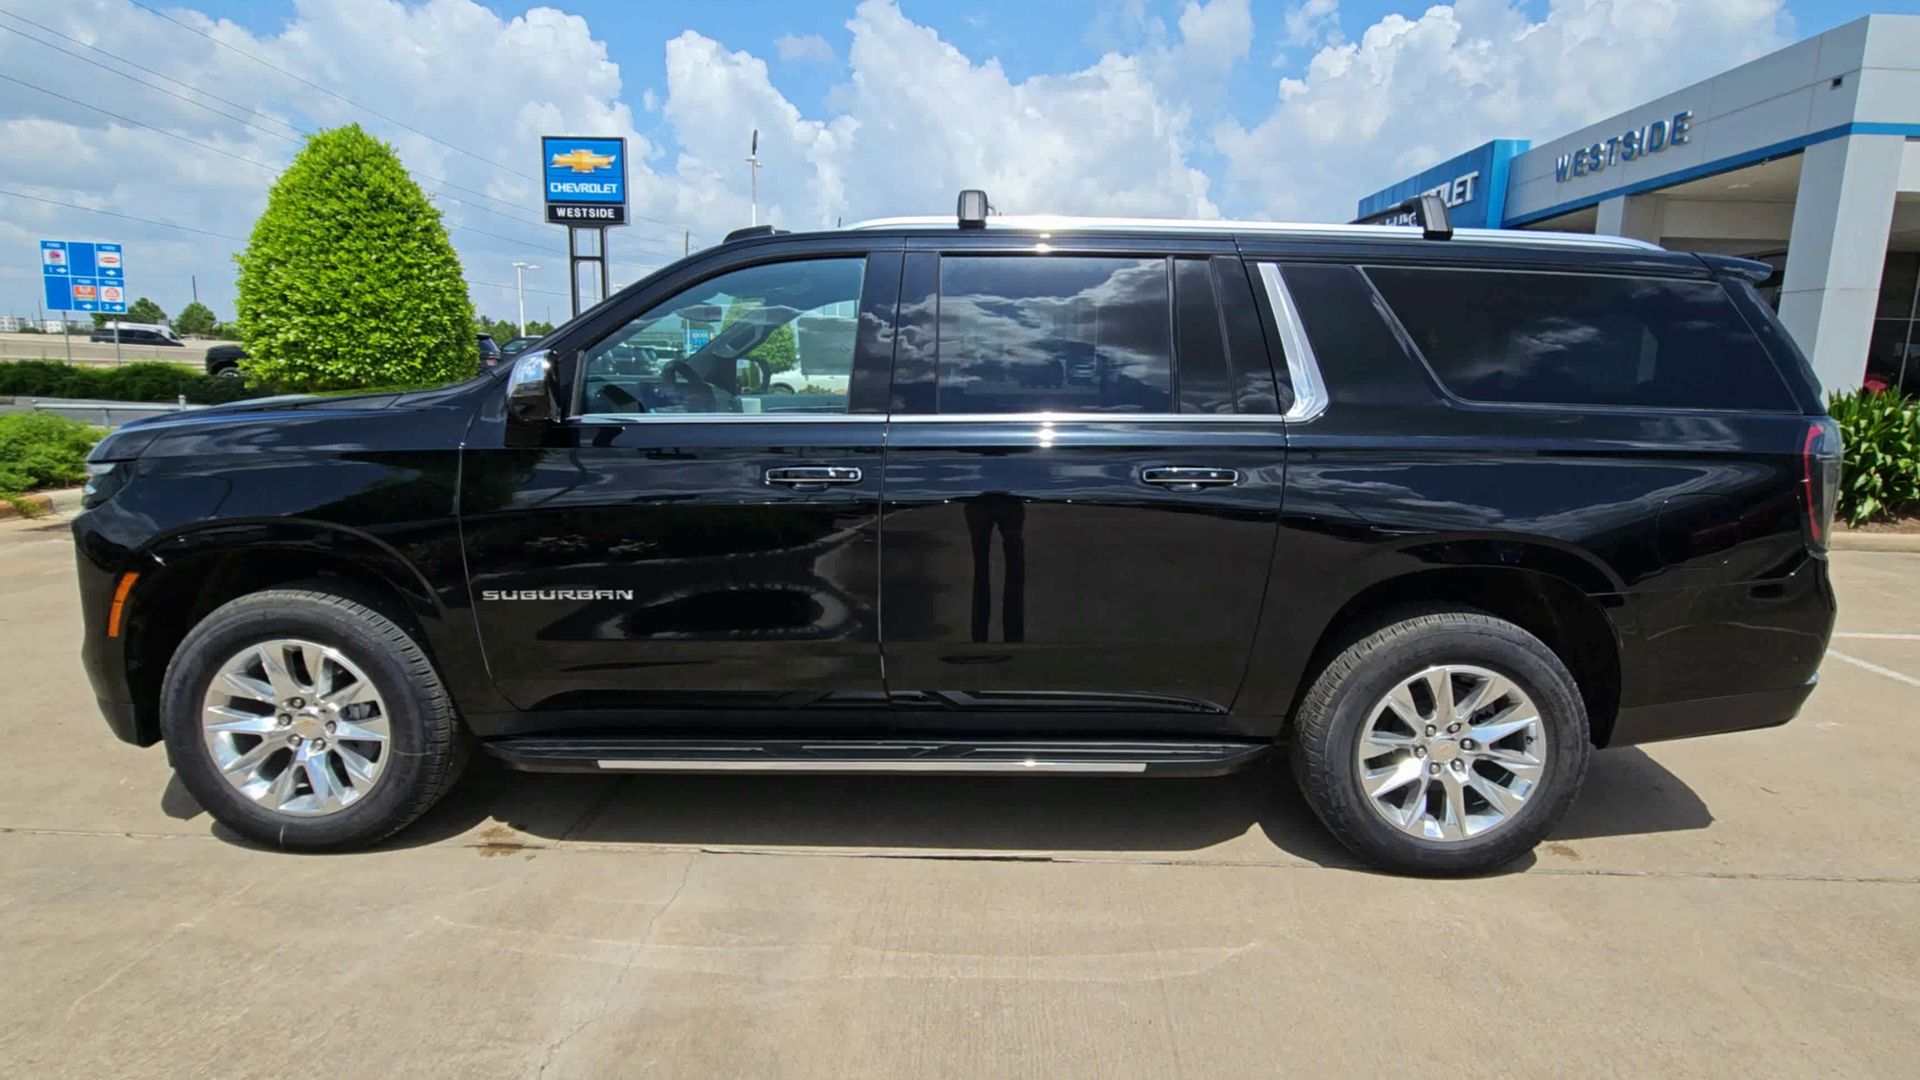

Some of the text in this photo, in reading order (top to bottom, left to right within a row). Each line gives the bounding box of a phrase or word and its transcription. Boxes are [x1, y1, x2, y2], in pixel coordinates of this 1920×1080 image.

[1555, 110, 1694, 183] WESTSIDE
[550, 182, 618, 194] CHEVROLET
[556, 207, 615, 219] WESTSIDE
[482, 590, 634, 600] SUBURBAN
